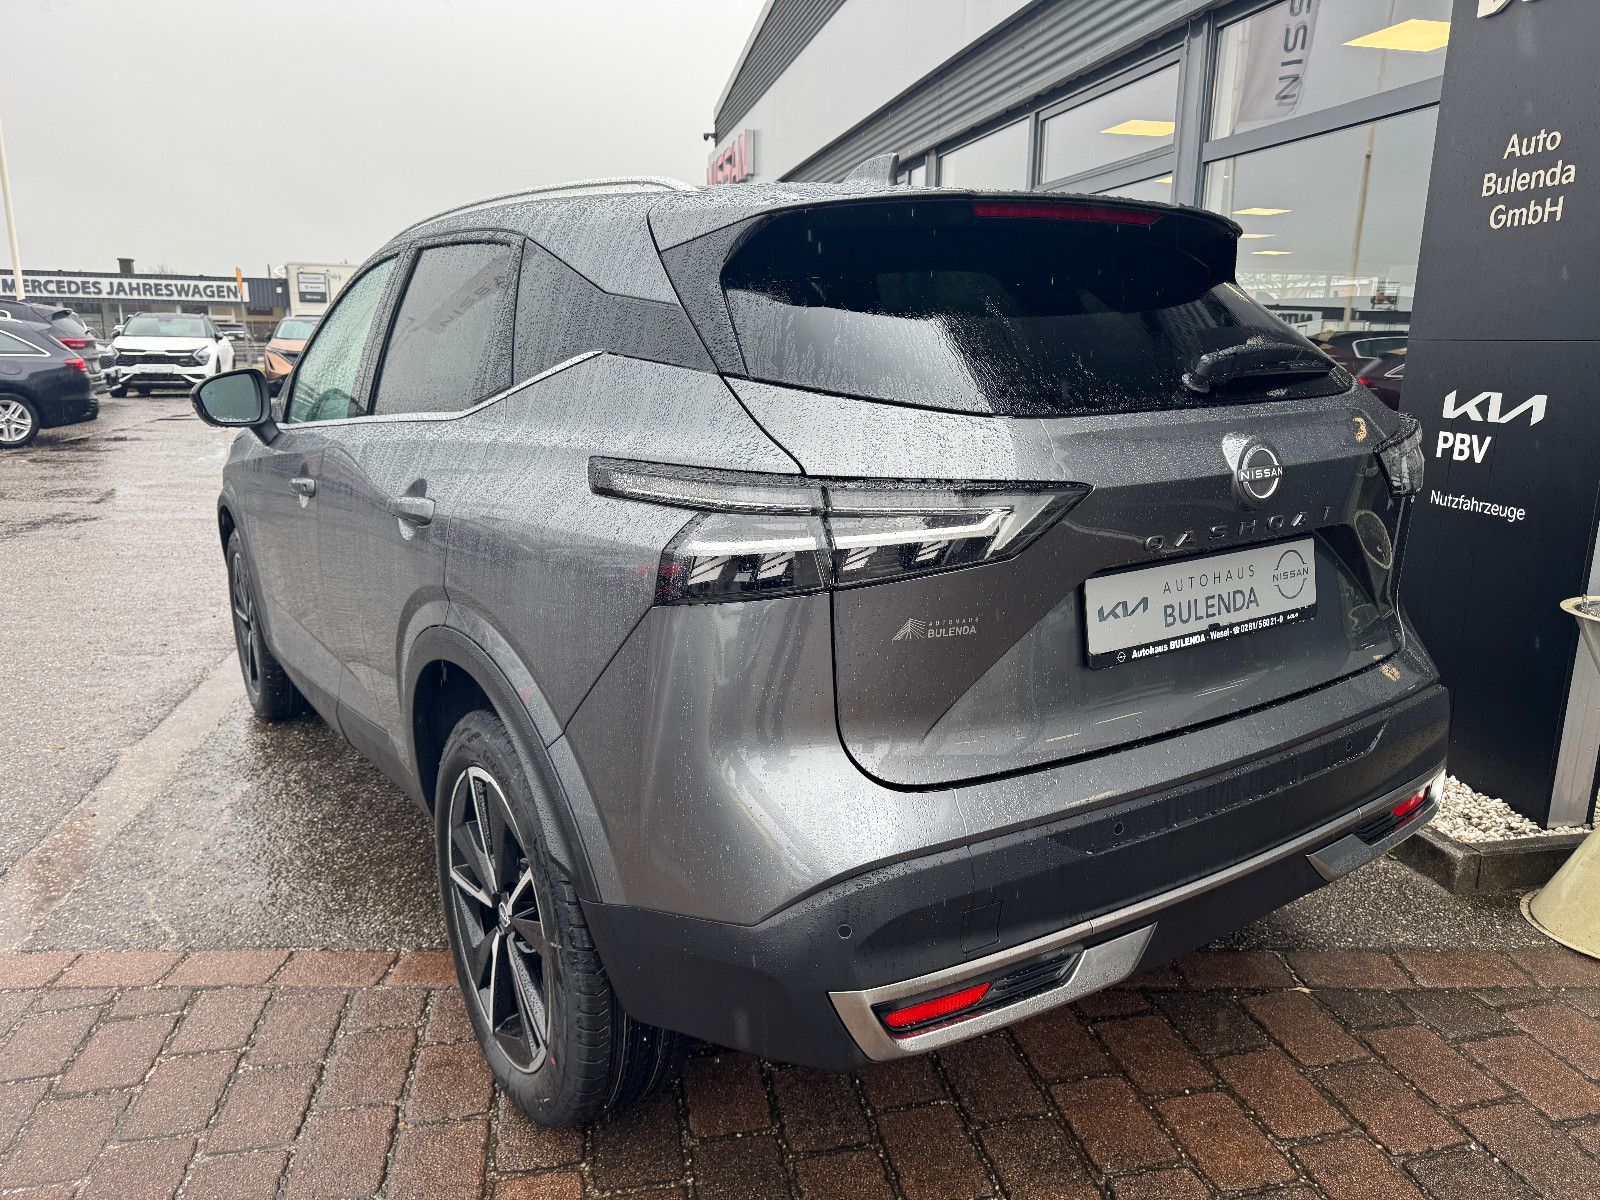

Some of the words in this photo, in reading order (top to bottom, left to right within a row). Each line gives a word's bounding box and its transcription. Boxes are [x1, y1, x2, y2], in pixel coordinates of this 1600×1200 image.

[1503, 128, 1562, 160] Auto
[1481, 159, 1577, 198] Bulenda
[1489, 195, 1565, 230] GmbH
[1, 278, 102, 296] MERCEDES
[106, 281, 239, 300] JAHRESWAGEN
[1442, 389, 1548, 427] KIA
[1435, 430, 1493, 464] PBV
[1239, 466, 1284, 483] NISSAN
[1430, 489, 1526, 523] Nutzfahrzeuge
[1143, 506, 1331, 552] QASHQAI
[1162, 563, 1256, 595] AUTOHAUS
[1272, 565, 1310, 583] NISSAN
[1097, 596, 1149, 623] KIA
[1163, 586, 1260, 628] BULENDA
[927, 625, 977, 639] BULENDA
[1131, 643, 1169, 660] Autohaus
[1169, 633, 1206, 650] BULENDA
[1209, 627, 1230, 641] Wesel
